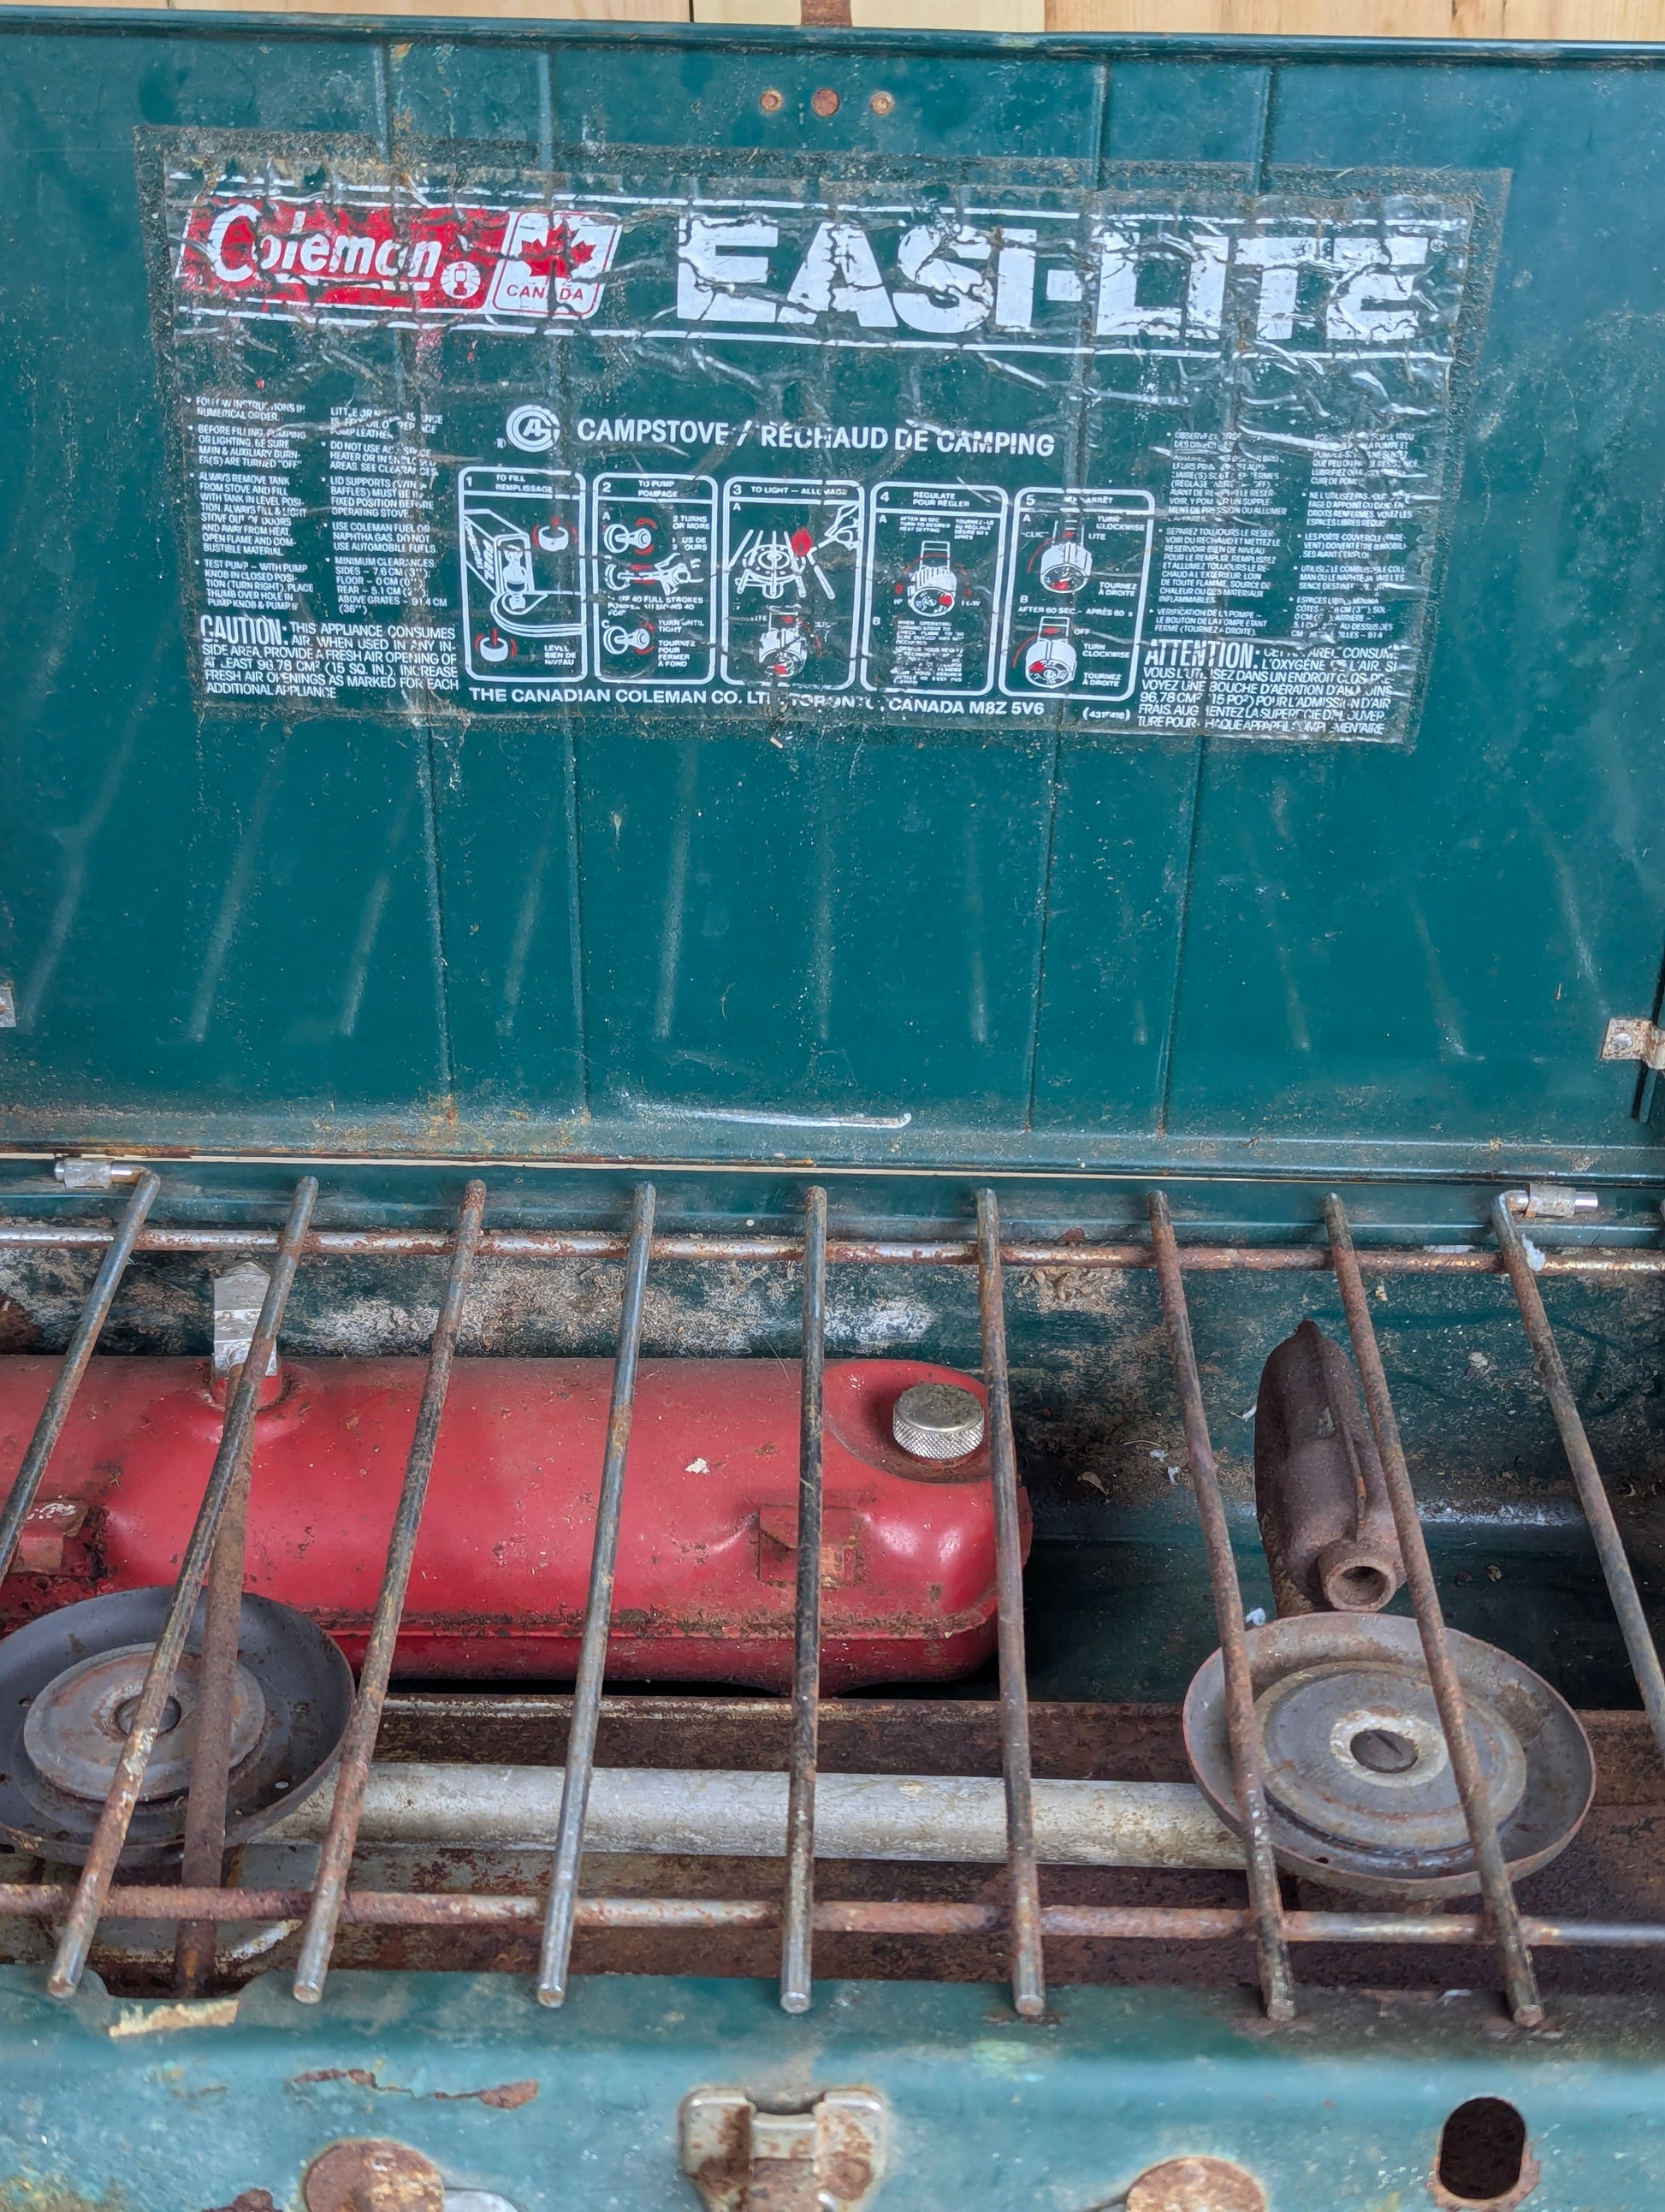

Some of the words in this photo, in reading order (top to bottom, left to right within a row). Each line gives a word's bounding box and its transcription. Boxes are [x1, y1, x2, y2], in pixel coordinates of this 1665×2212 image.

[578, 418, 729, 446] CAMPSTOVE
[894, 427, 928, 451] DE
[937, 430, 1055, 457] CAMPING
[330, 441, 342, 449] DO
[345, 442, 362, 450] NOT
[364, 444, 380, 453] USE
[330, 452, 361, 461] HEATER
[361, 463, 376, 472] SEE
[269, 477, 289, 485] TANK
[330, 476, 344, 484] LID
[346, 477, 390, 488] SUPPORTS
[465, 476, 472, 487] 1
[200, 482, 222, 491] FROM
[224, 483, 251, 494] STOVE
[252, 486, 270, 495] AND
[272, 487, 288, 495] FILL
[602, 482, 611, 493] 2
[733, 484, 742, 495] 3
[372, 489, 395, 498] MUST
[880, 491, 890, 502] 4
[200, 493, 222, 501] WITH
[256, 495, 280, 506] LEVEL
[356, 498, 397, 508] POSITION
[1026, 495, 1035, 506] 5
[331, 507, 378, 517] OPERATING
[733, 502, 741, 511] A
[602, 512, 611, 520] A
[879, 514, 887, 524] A
[202, 524, 219, 532] AND
[332, 522, 348, 531] USE
[350, 523, 392, 532] COLEMAN
[394, 524, 415, 532] FUEL
[203, 532, 225, 543] OPEN
[227, 535, 252, 544] FLAME
[255, 537, 272, 545] AND
[333, 532, 373, 542] NAPHTHA
[334, 543, 349, 551] USE
[204, 559, 223, 568] TEST
[225, 560, 248, 570] PUMP
[259, 563, 281, 572] WITH
[283, 564, 308, 572] PUMP
[335, 557, 376, 566] MINIMUM
[204, 569, 228, 578] KNOB
[241, 572, 273, 581] CLOSED
[335, 566, 361, 575] SIDES
[206, 578, 225, 588] TION
[287, 584, 313, 592] PLACE
[336, 577, 364, 585] FLOOR
[383, 578, 398, 586] CM
[207, 589, 236, 598] THUMB
[238, 590, 259, 600] OVER
[261, 592, 281, 601] HOLE
[337, 585, 359, 594] REAR
[387, 587, 400, 596] CM
[207, 598, 232, 607] PUMP
[338, 596, 366, 604] ABOVE
[368, 596, 400, 604] GRATES
[433, 598, 447, 607] CM
[601, 620, 610, 628] C
[288, 621, 317, 634] THIS
[321, 623, 382, 637] APPLIANCE
[388, 626, 455, 639] CONSUMES
[292, 635, 313, 646] AIR.
[317, 637, 353, 649] WHEN
[358, 638, 388, 650] USED
[394, 640, 406, 650] IN
[411, 641, 436, 652] ANY
[440, 642, 455, 652] IN-
[202, 643, 228, 656] SIDE
[231, 645, 262, 658] AREA,
[264, 646, 314, 660] PROVIDE
[316, 649, 323, 660] A
[326, 649, 361, 661] FRESH
[364, 651, 382, 662] AIR
[385, 651, 439, 665] OPENING
[441, 654, 457, 665] OF
[1145, 639, 1260, 669] ATTENTION:
[221, 657, 253, 669] LEAST
[349, 664, 368, 674] SQ.
[400, 665, 458, 678] INCREASE
[1385, 661, 1397, 672] SI
[204, 669, 241, 682] FRESH
[245, 671, 263, 683] AIR
[329, 675, 344, 686] AS
[347, 676, 396, 689] MARKED
[400, 678, 423, 690] FOR
[429, 679, 459, 691] EACH
[1143, 667, 1176, 679] VOUS
[1236, 670, 1268, 682] DANS
[1270, 672, 1287, 683] UN
[1288, 673, 1336, 684] ENDROIT
[207, 682, 274, 696] ADDITIONAL
[1142, 679, 1178, 691] VOYEZ
[1182, 680, 1206, 691] UNE
[1209, 683, 1258, 693] BOUCHE
[470, 687, 507, 702] THE
[511, 688, 610, 703] CANADIAN
[615, 690, 707, 703] COLEMAN
[711, 691, 743, 704] CO.
[888, 697, 964, 714] CANADA
[969, 702, 1006, 715] M8Z
[1011, 702, 1045, 715] 5V6
[1141, 692, 1176, 703] 96,78
[1361, 698, 1390, 709] D'AIR
[1138, 716, 1164, 726] TURE
[1165, 717, 1196, 727] POUR
